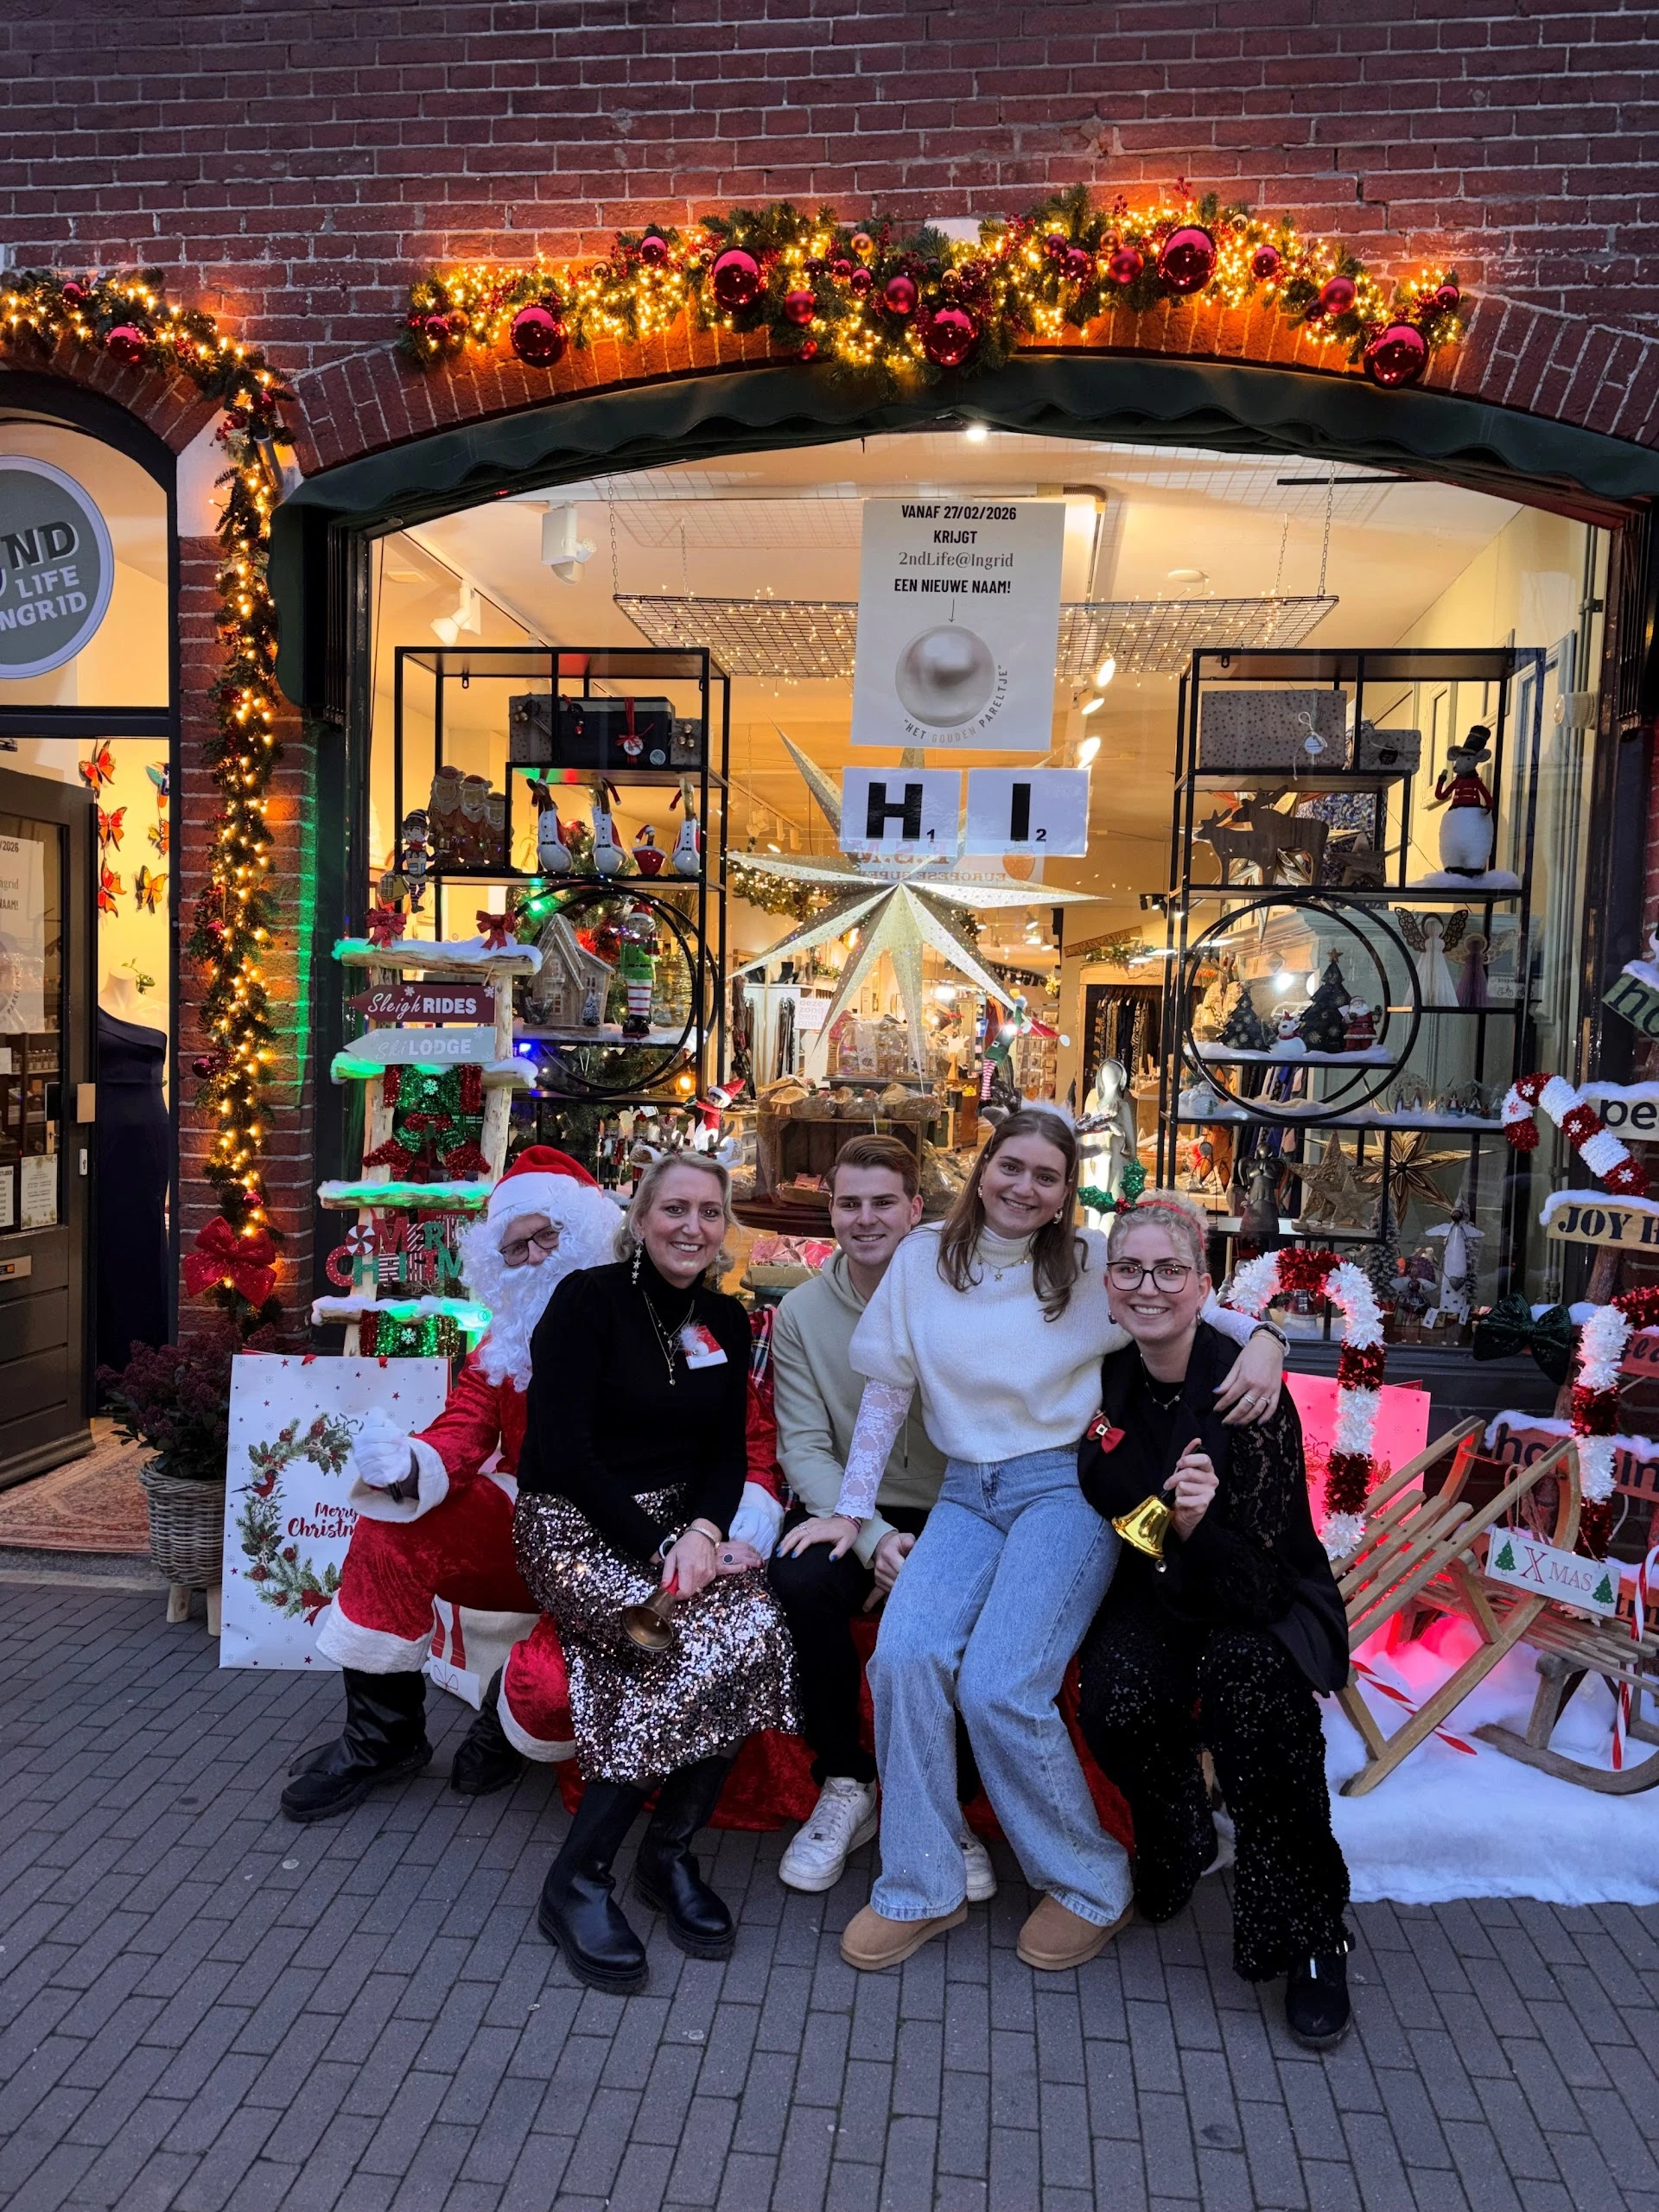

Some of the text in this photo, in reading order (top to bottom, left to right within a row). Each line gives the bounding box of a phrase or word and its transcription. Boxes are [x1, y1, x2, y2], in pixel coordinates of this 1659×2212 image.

[901, 505, 1017, 520] VANAF 27/02/2026
[933, 530, 978, 543] KRIJGT
[899, 551, 1014, 569] 2ndLife@Ingrid
[15, 564, 79, 599] LIFE
[893, 578, 1012, 594] EEN NIEUWE NAAM!
[931, 728, 977, 743] GOUDEN
[367, 993, 477, 1020] Sleigh RIDES
[375, 1038, 472, 1060] Ski LODGE
[1558, 1205, 1633, 1240] JOY
[315, 1502, 359, 1523] Merry
